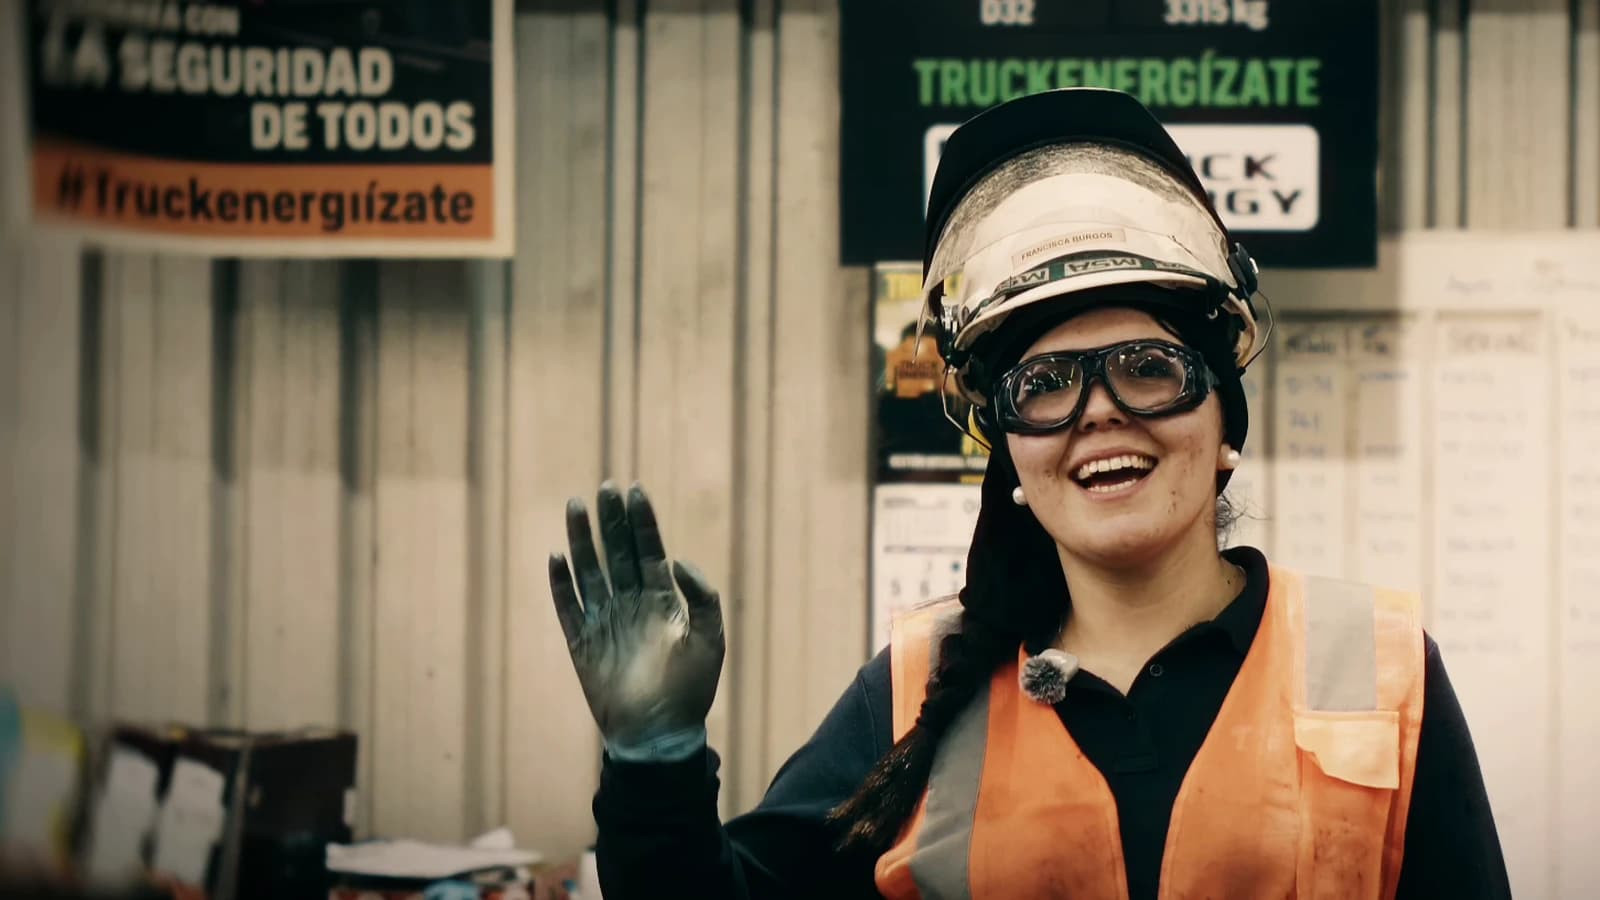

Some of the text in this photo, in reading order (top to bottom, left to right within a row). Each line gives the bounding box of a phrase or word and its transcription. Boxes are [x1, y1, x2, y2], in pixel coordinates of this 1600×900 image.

[1233, 0, 1269, 30] kg
[119, 34, 394, 97] SEGURIDAD
[914, 50, 1321, 106] TRUCKENERGÍZATE
[250, 102, 476, 151] DE TODOS
[1021, 232, 1113, 261] FRANCISCA BURGOS
[1067, 257, 1138, 273] MSA
